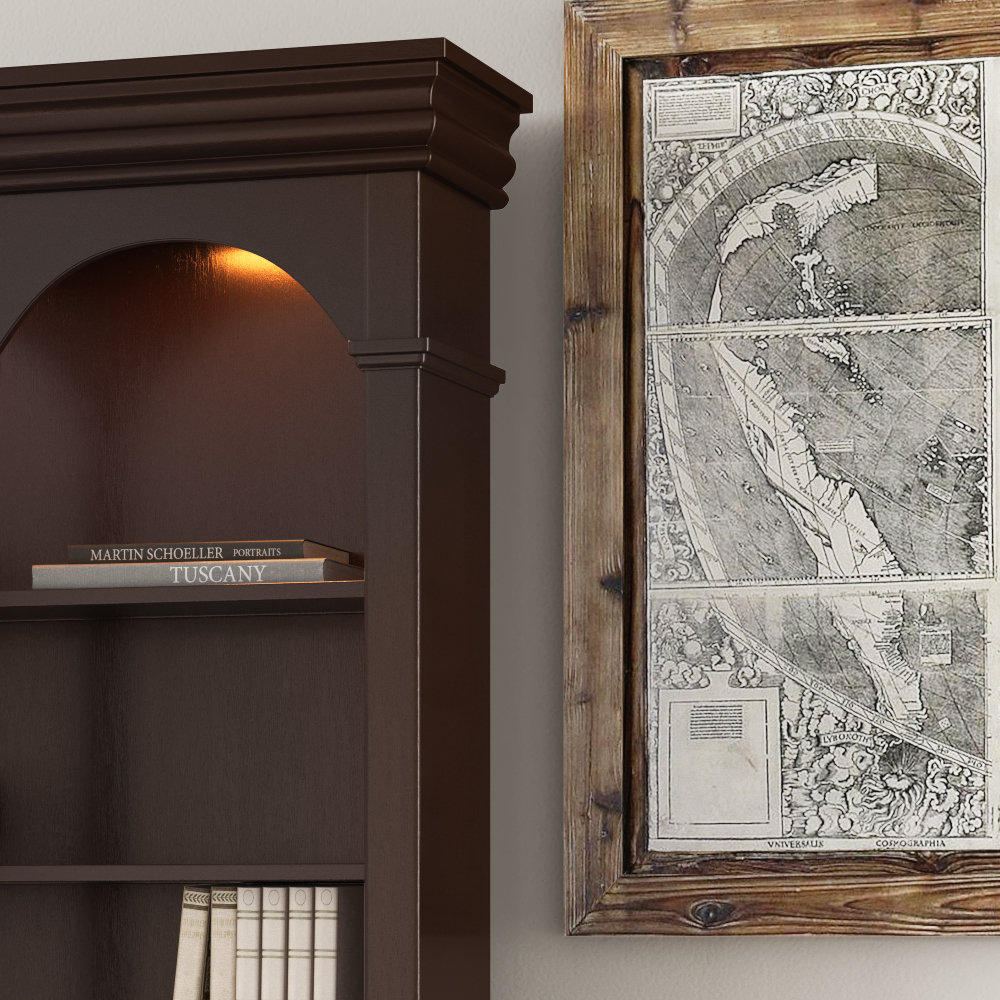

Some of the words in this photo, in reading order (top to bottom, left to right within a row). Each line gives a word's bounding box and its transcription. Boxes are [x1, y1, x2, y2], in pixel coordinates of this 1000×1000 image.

[90, 548, 144, 561] MARTIN
[146, 546, 224, 560] SCHOELLER
[233, 547, 281, 557] PORTRAITS
[170, 564, 267, 584] TUSCANY
